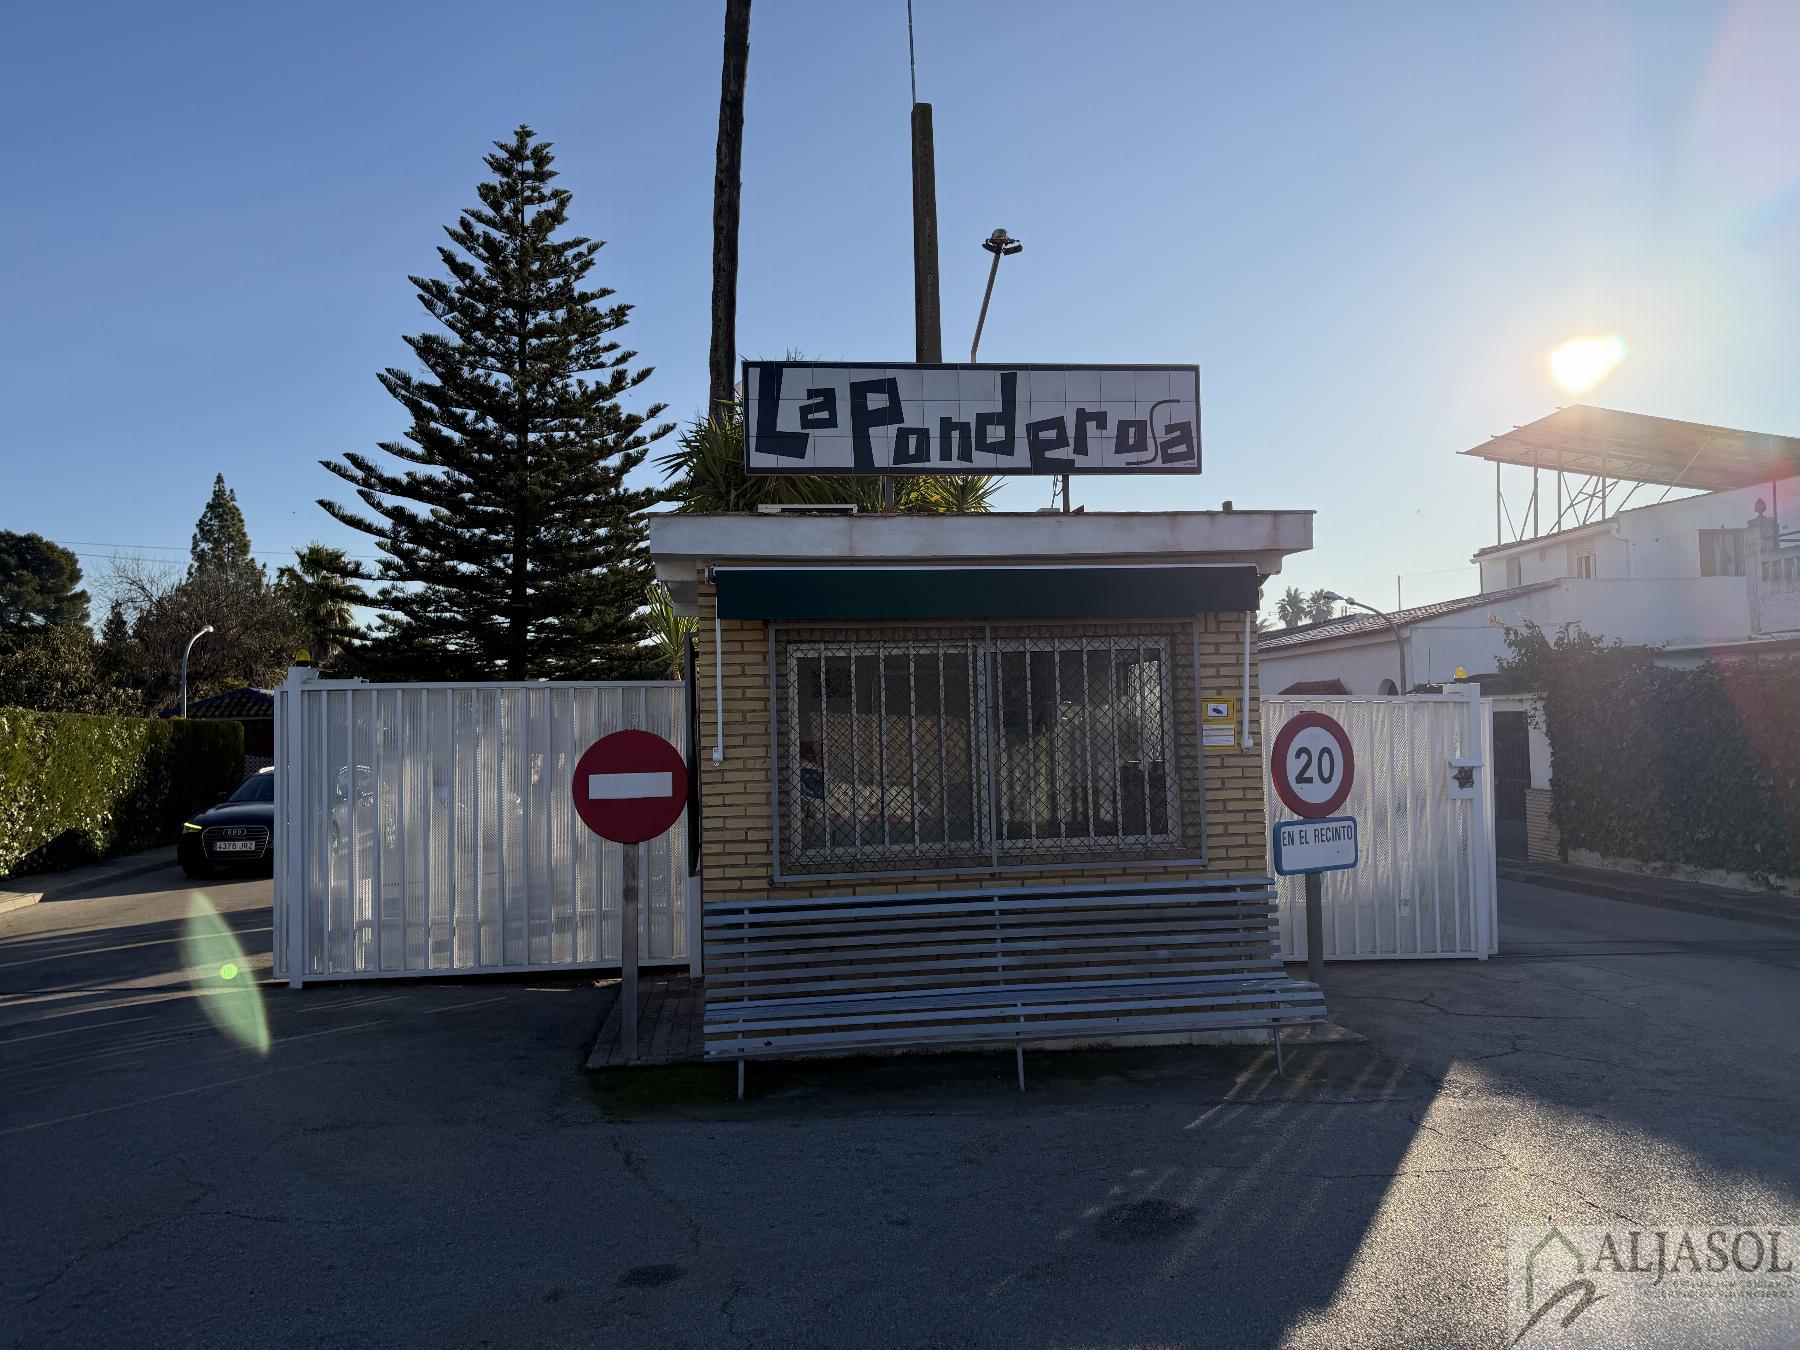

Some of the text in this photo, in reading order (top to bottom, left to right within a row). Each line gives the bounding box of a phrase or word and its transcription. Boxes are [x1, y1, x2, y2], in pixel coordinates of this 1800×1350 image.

[755, 367, 1196, 468] La Ponderosa
[1294, 746, 1335, 784] 20
[1282, 825, 1353, 847] EN EL RECINTO
